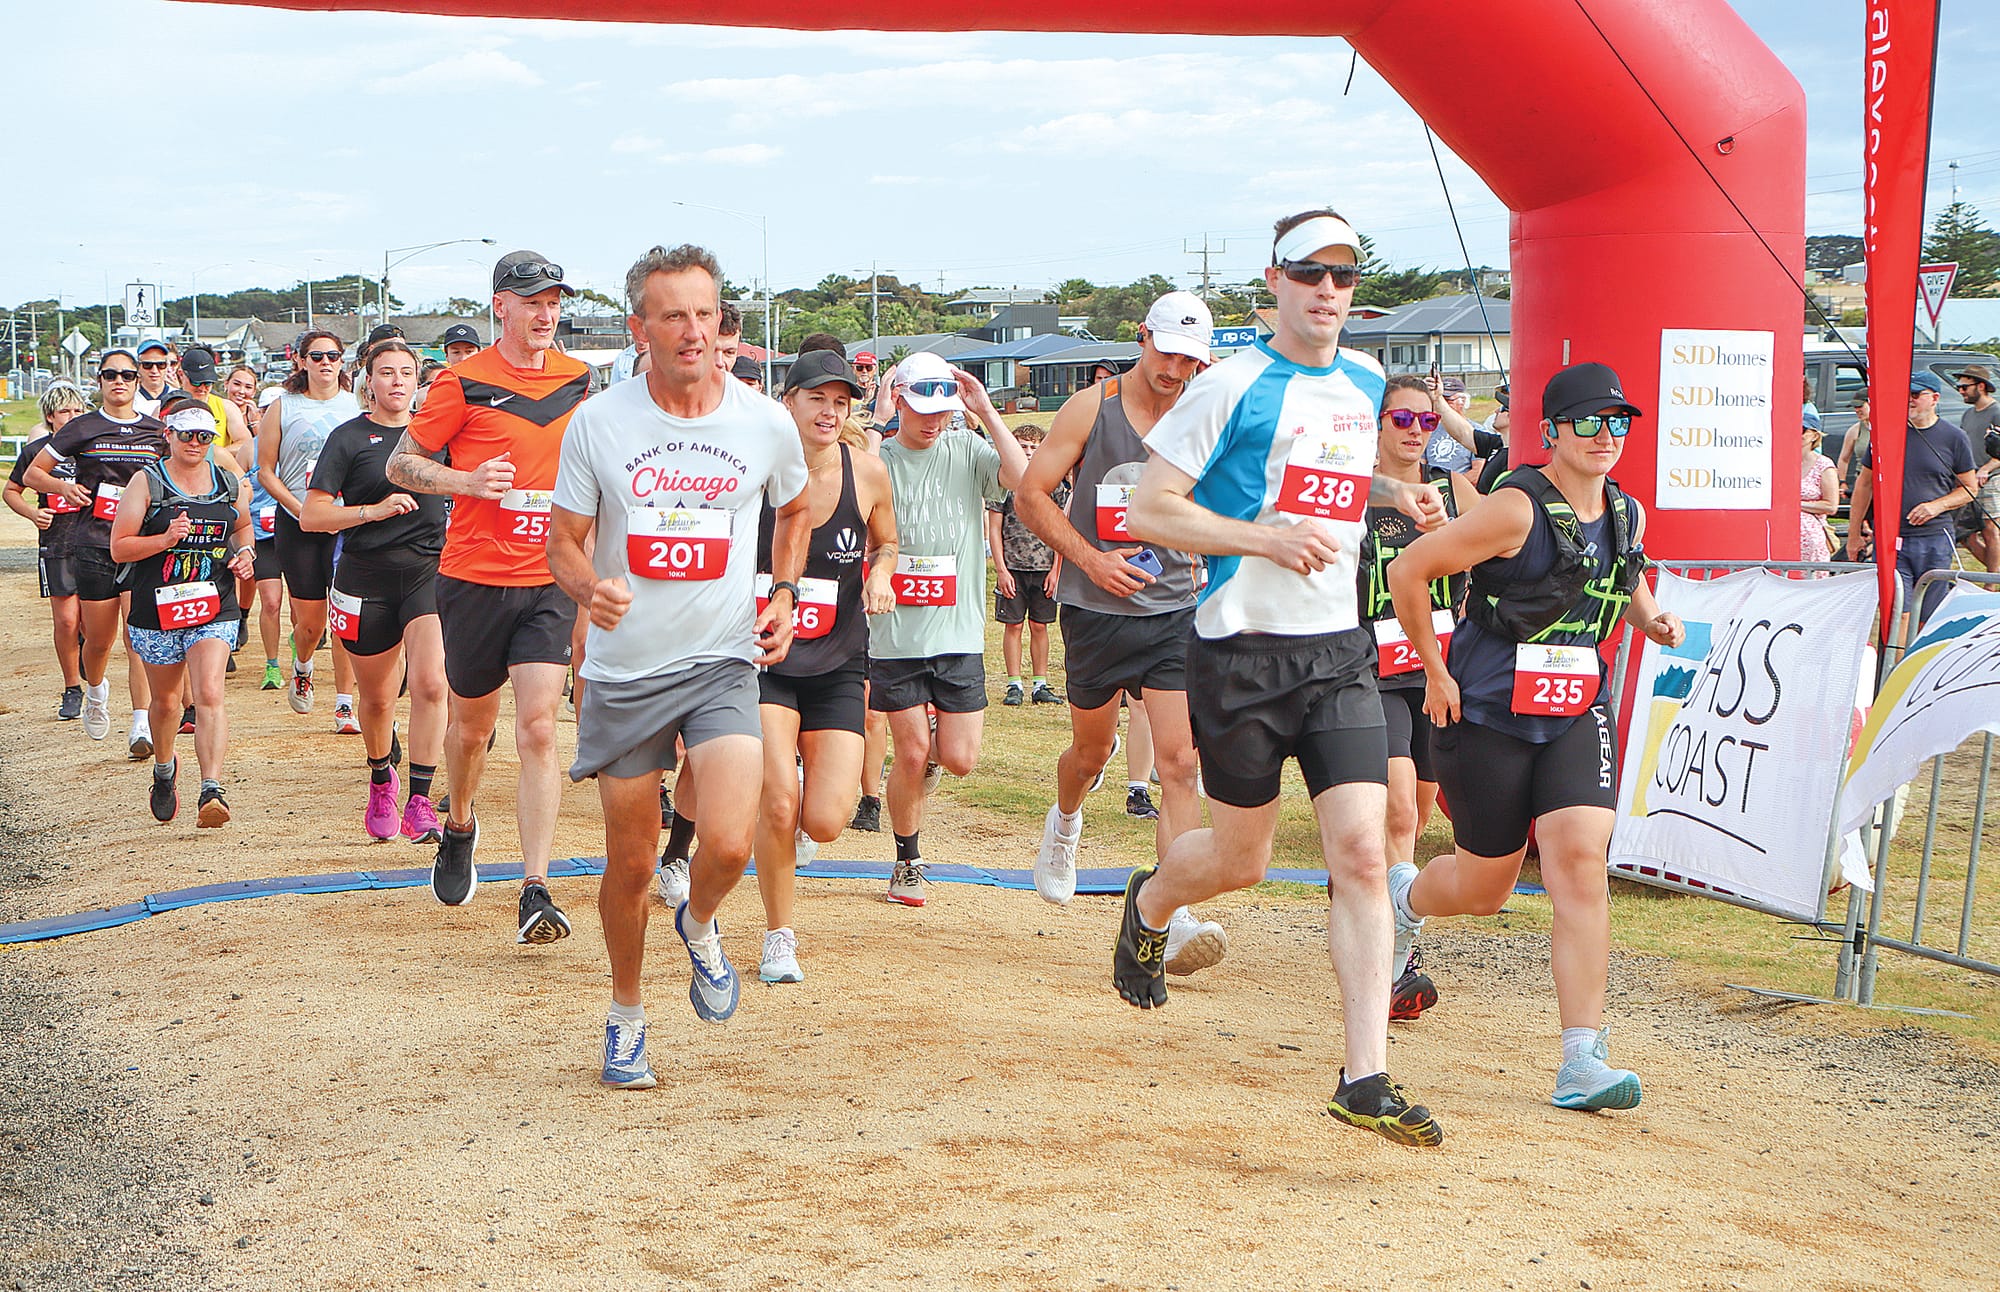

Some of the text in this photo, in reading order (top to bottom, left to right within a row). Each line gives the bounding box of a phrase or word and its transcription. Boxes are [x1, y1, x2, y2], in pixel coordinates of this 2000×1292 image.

[1927, 274, 1945, 286] GIVE
[1672, 345, 1767, 366] SJDhomes
[1671, 386, 1766, 407] SJDhomes
[1333, 422, 1352, 432] CITY
[1669, 427, 1764, 448] SJDhomes
[626, 442, 748, 475] BANK OF AMERICA
[632, 467, 738, 501] Chicago
[908, 478, 942, 502] NIKE
[1668, 468, 1762, 488] SJDhomes
[1298, 474, 1355, 508] 238
[901, 496, 964, 526] UNNING
[1314, 508, 1330, 516] 10KM
[901, 520, 966, 546] IVISION
[648, 542, 706, 569] 201
[826, 550, 862, 560] VOYAGE
[902, 578, 944, 598] 233
[172, 600, 210, 622] 232
[330, 604, 347, 630] 26
[792, 606, 819, 630] 46
[1533, 678, 1584, 704] 235
[1656, 723, 1769, 814] COAST
